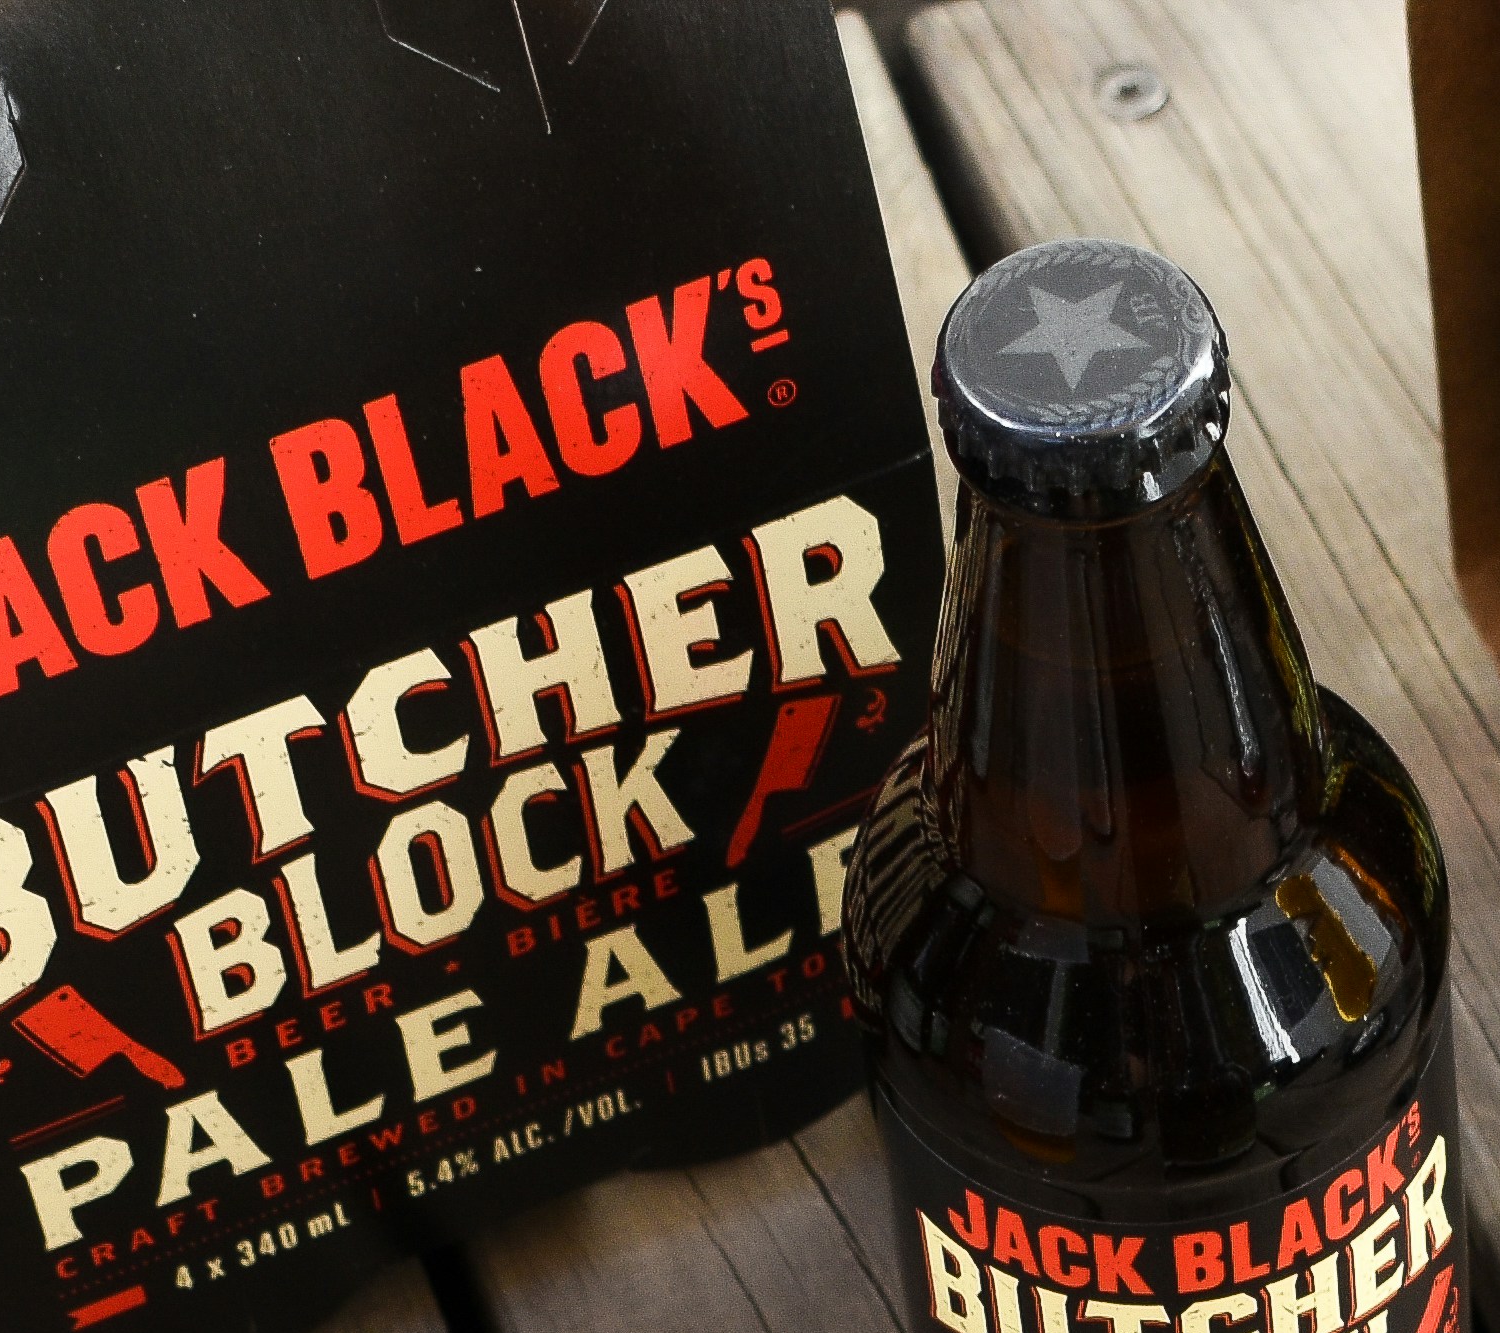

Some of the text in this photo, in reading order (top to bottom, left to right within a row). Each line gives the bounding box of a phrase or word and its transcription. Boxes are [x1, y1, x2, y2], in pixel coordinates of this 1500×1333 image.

[268, 255, 792, 581] BLACK'S
[167, 728, 699, 1039] BLOCK
[225, 868, 681, 1071] BEER BIÈRE
[19, 988, 501, 1253] PALE
[56, 992, 736, 1280] CRAFT BREWED IN CAPE
[175, 1263, 195, 1290] 4
[207, 1255, 227, 1280] x
[235, 1228, 299, 1267] 340
[407, 1144, 482, 1198] 5.4%
[700, 1040, 770, 1083] IBUs
[779, 1014, 817, 1050] 35
[948, 1099, 1422, 1296] JACK BLACK'S
